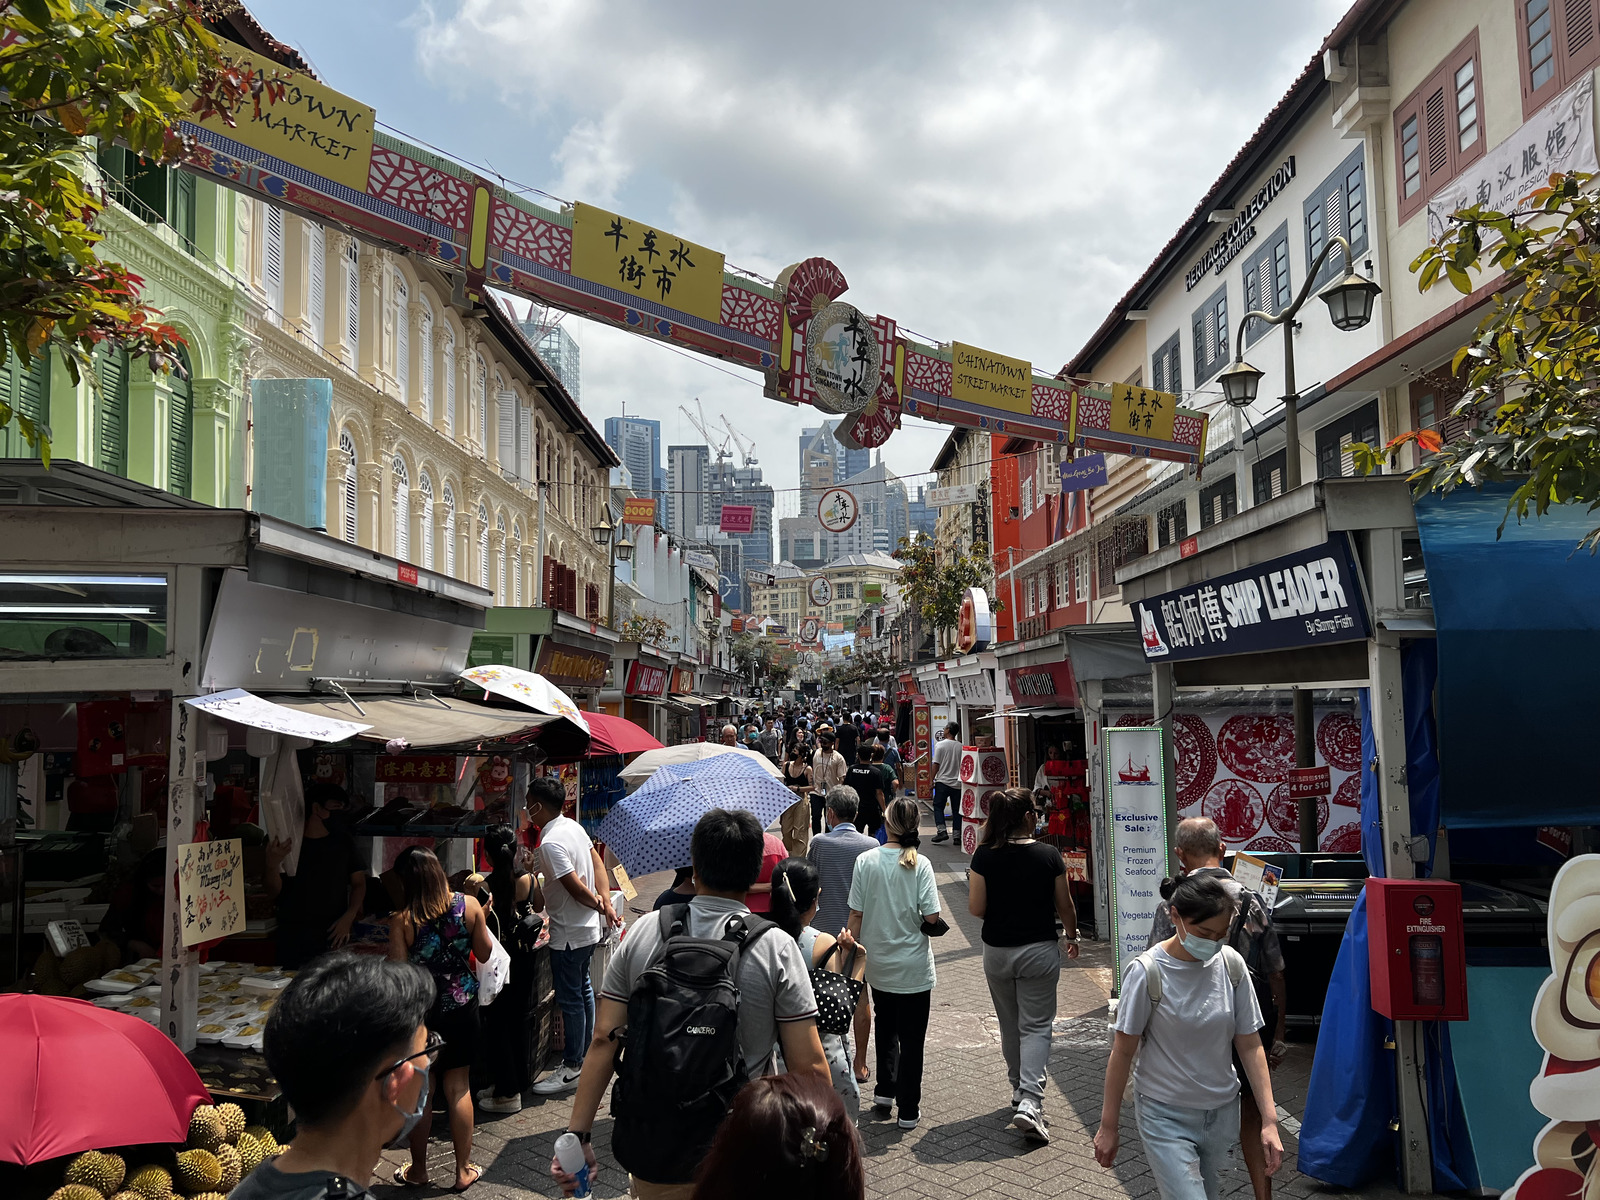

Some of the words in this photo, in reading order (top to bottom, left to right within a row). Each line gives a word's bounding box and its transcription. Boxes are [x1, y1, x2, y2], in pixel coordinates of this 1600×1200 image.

[251, 107, 357, 160] MARKET
[1518, 164, 1550, 196] DESIGN
[1184, 231, 1228, 292] HERITAGE
[1226, 155, 1296, 244] COLLECTION
[618, 254, 677, 302] 街市
[789, 265, 843, 316] WELCOME
[957, 351, 1027, 381] CHINATOWN
[815, 368, 843, 382] CHINATOWN
[814, 378, 842, 391] SINGAPORE
[957, 373, 989, 390] STREET
[990, 382, 1027, 399] MARKET
[1128, 409, 1154, 435] 街市
[1220, 578, 1262, 629] SHIP
[1259, 557, 1348, 621] LEADER
[1299, 783, 1313, 791] for
[1314, 781, 1329, 790] $10
[1115, 813, 1158, 821] Exclusive
[1124, 824, 1145, 832] Sale
[1123, 846, 1156, 854] Premium
[1127, 857, 1153, 865] Frozen
[1125, 867, 1156, 876] Seafood
[1130, 889, 1153, 897] Meats
[1121, 912, 1155, 921] Vegetabl
[1406, 925, 1446, 933] EXTINGUISHER
[1126, 933, 1149, 941] Assort
[1127, 944, 1147, 952] Delic
